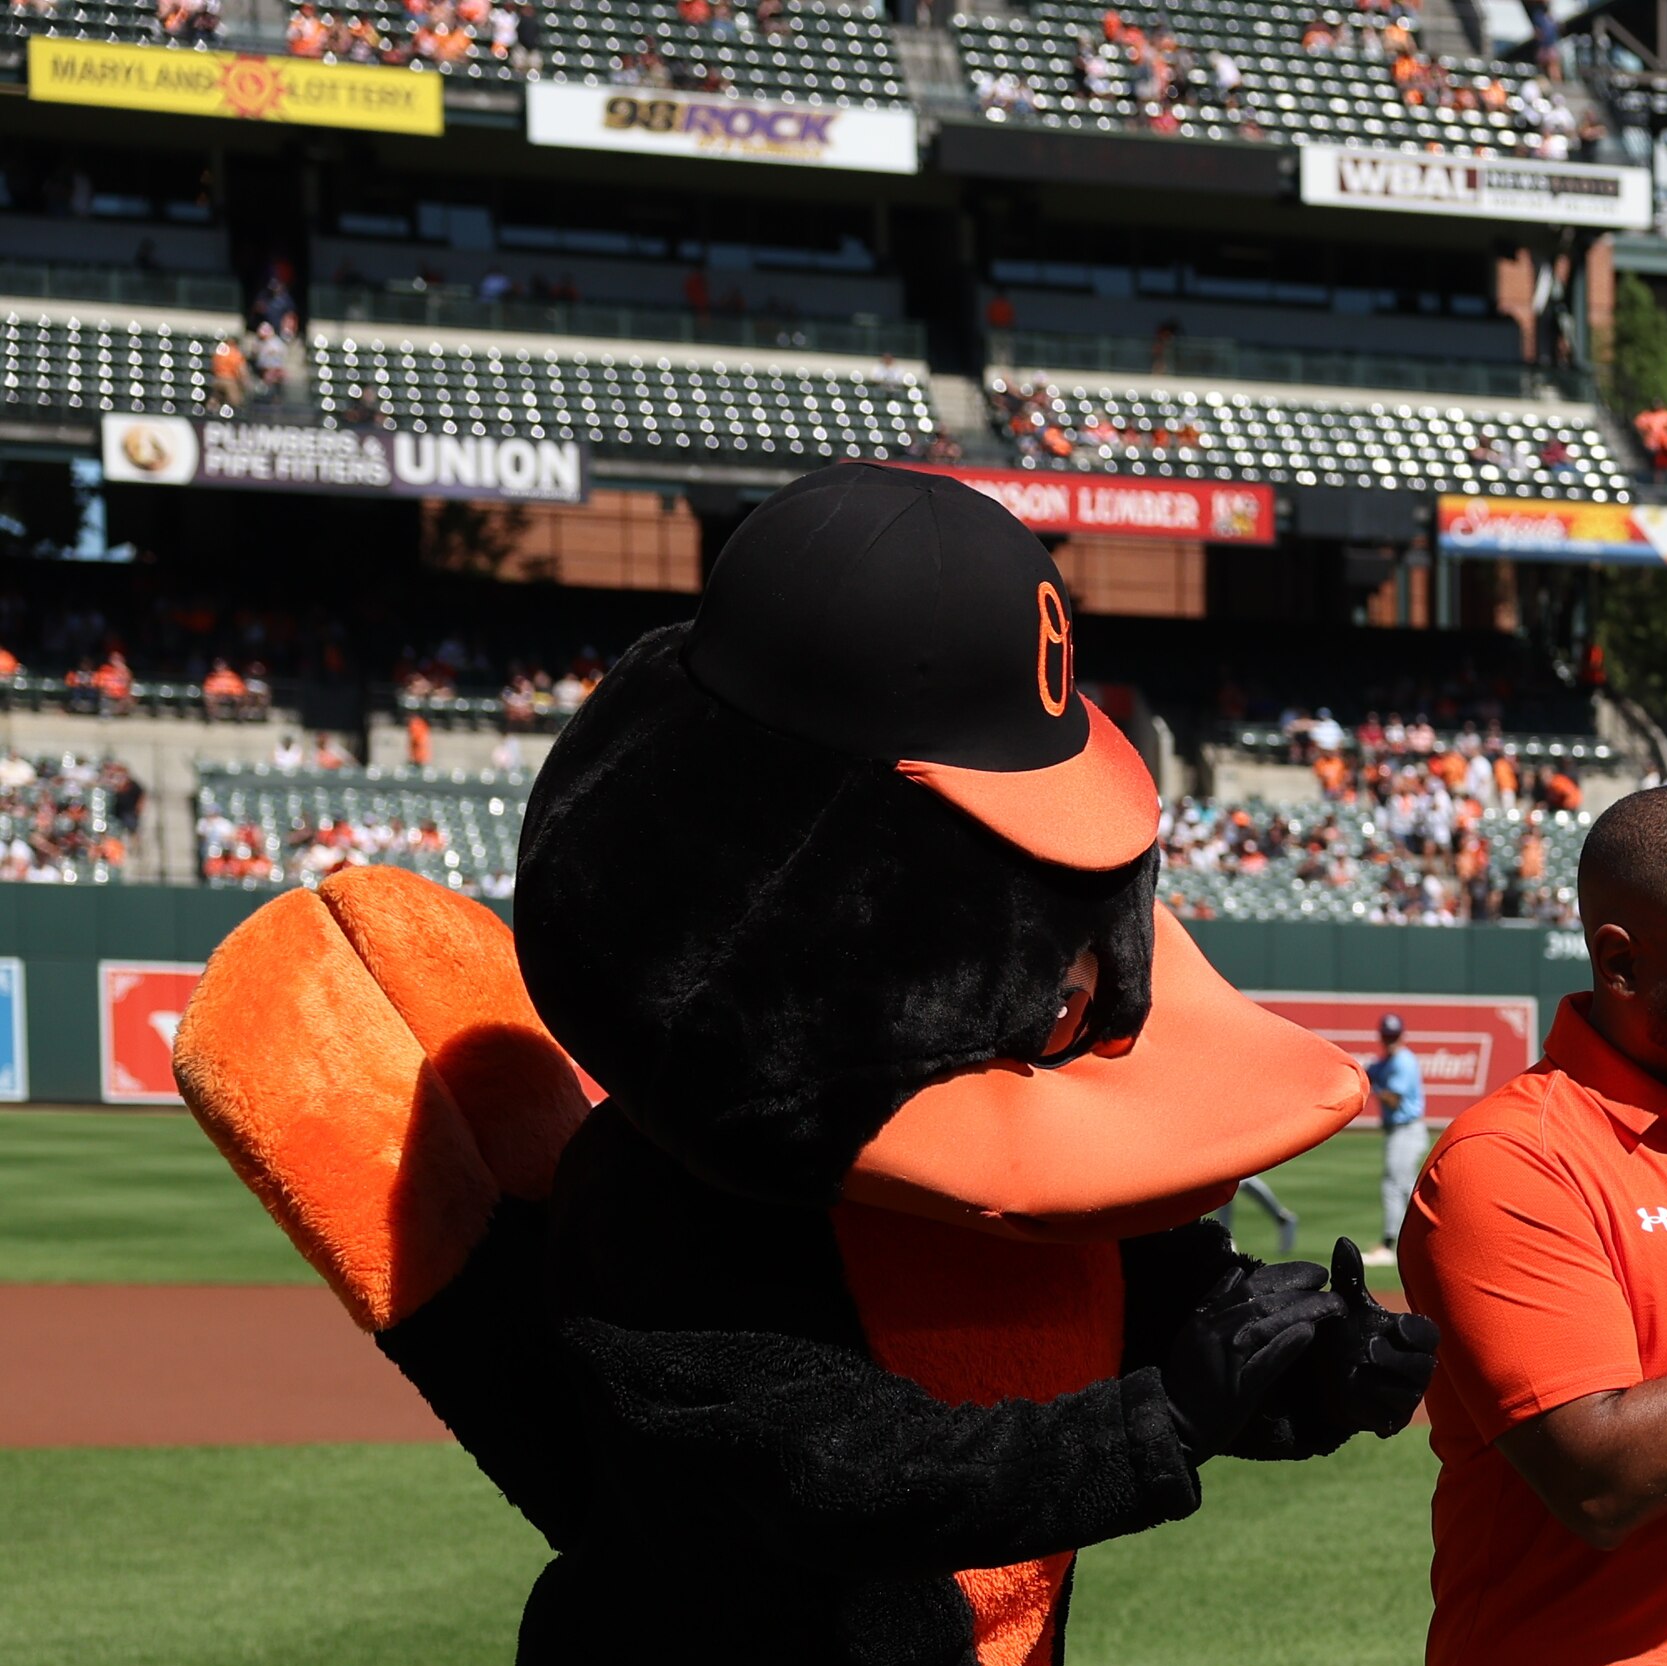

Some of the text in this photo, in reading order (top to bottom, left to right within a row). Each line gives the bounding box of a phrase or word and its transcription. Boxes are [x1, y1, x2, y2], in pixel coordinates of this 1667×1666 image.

[50, 53, 418, 113] MARYLAND LOTTERY
[1339, 157, 1477, 200] WBAL
[203, 421, 358, 457] PLUMBERS
[394, 432, 582, 496] UNION
[1077, 485, 1200, 529] LUMBER
